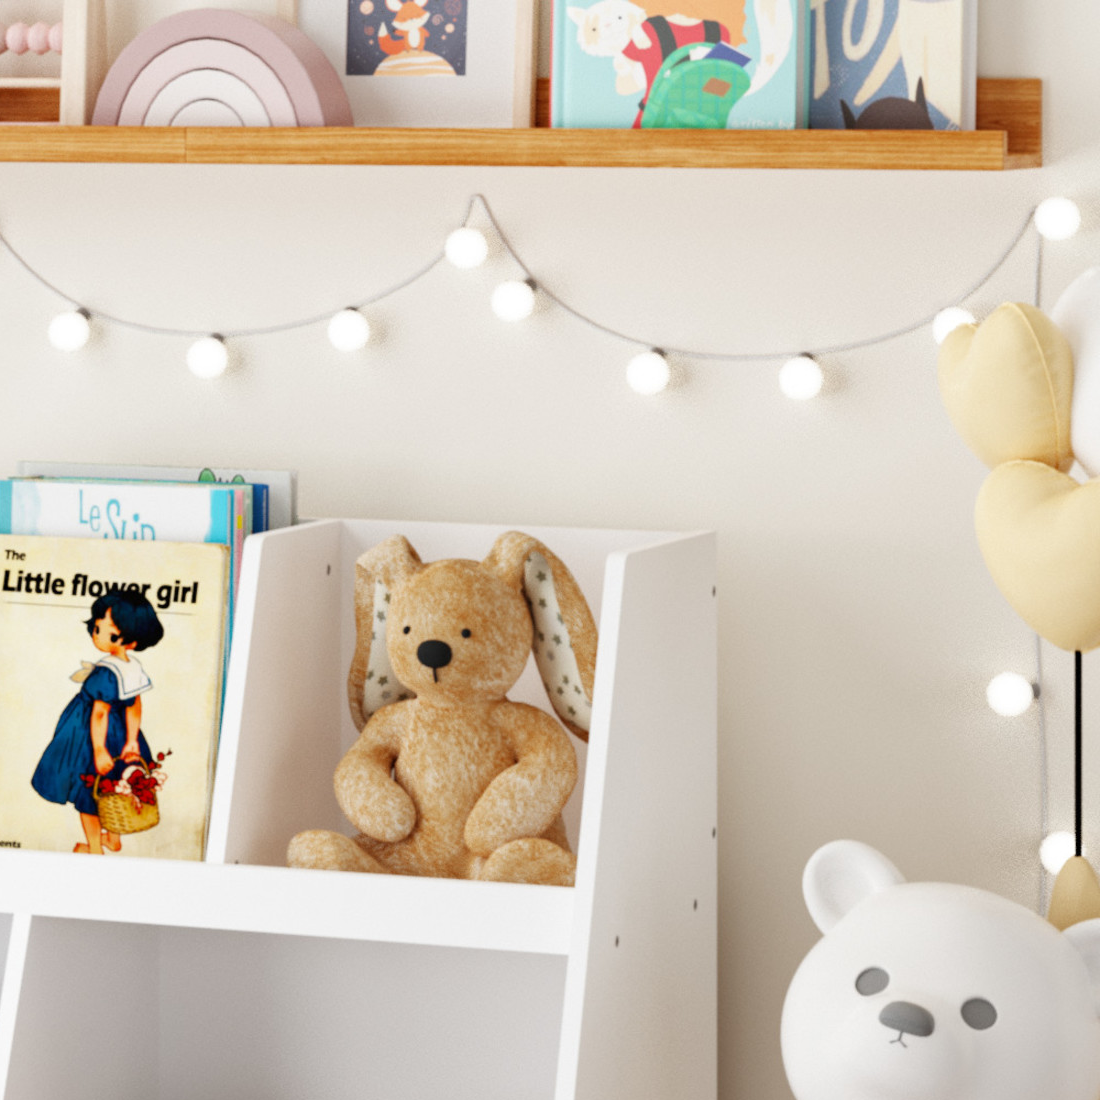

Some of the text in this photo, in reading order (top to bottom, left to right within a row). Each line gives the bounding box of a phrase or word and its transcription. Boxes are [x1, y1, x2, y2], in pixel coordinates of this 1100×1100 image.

[79, 489, 100, 532] Le
[5, 549, 26, 561] The
[2, 570, 199, 609] Little flower girl
